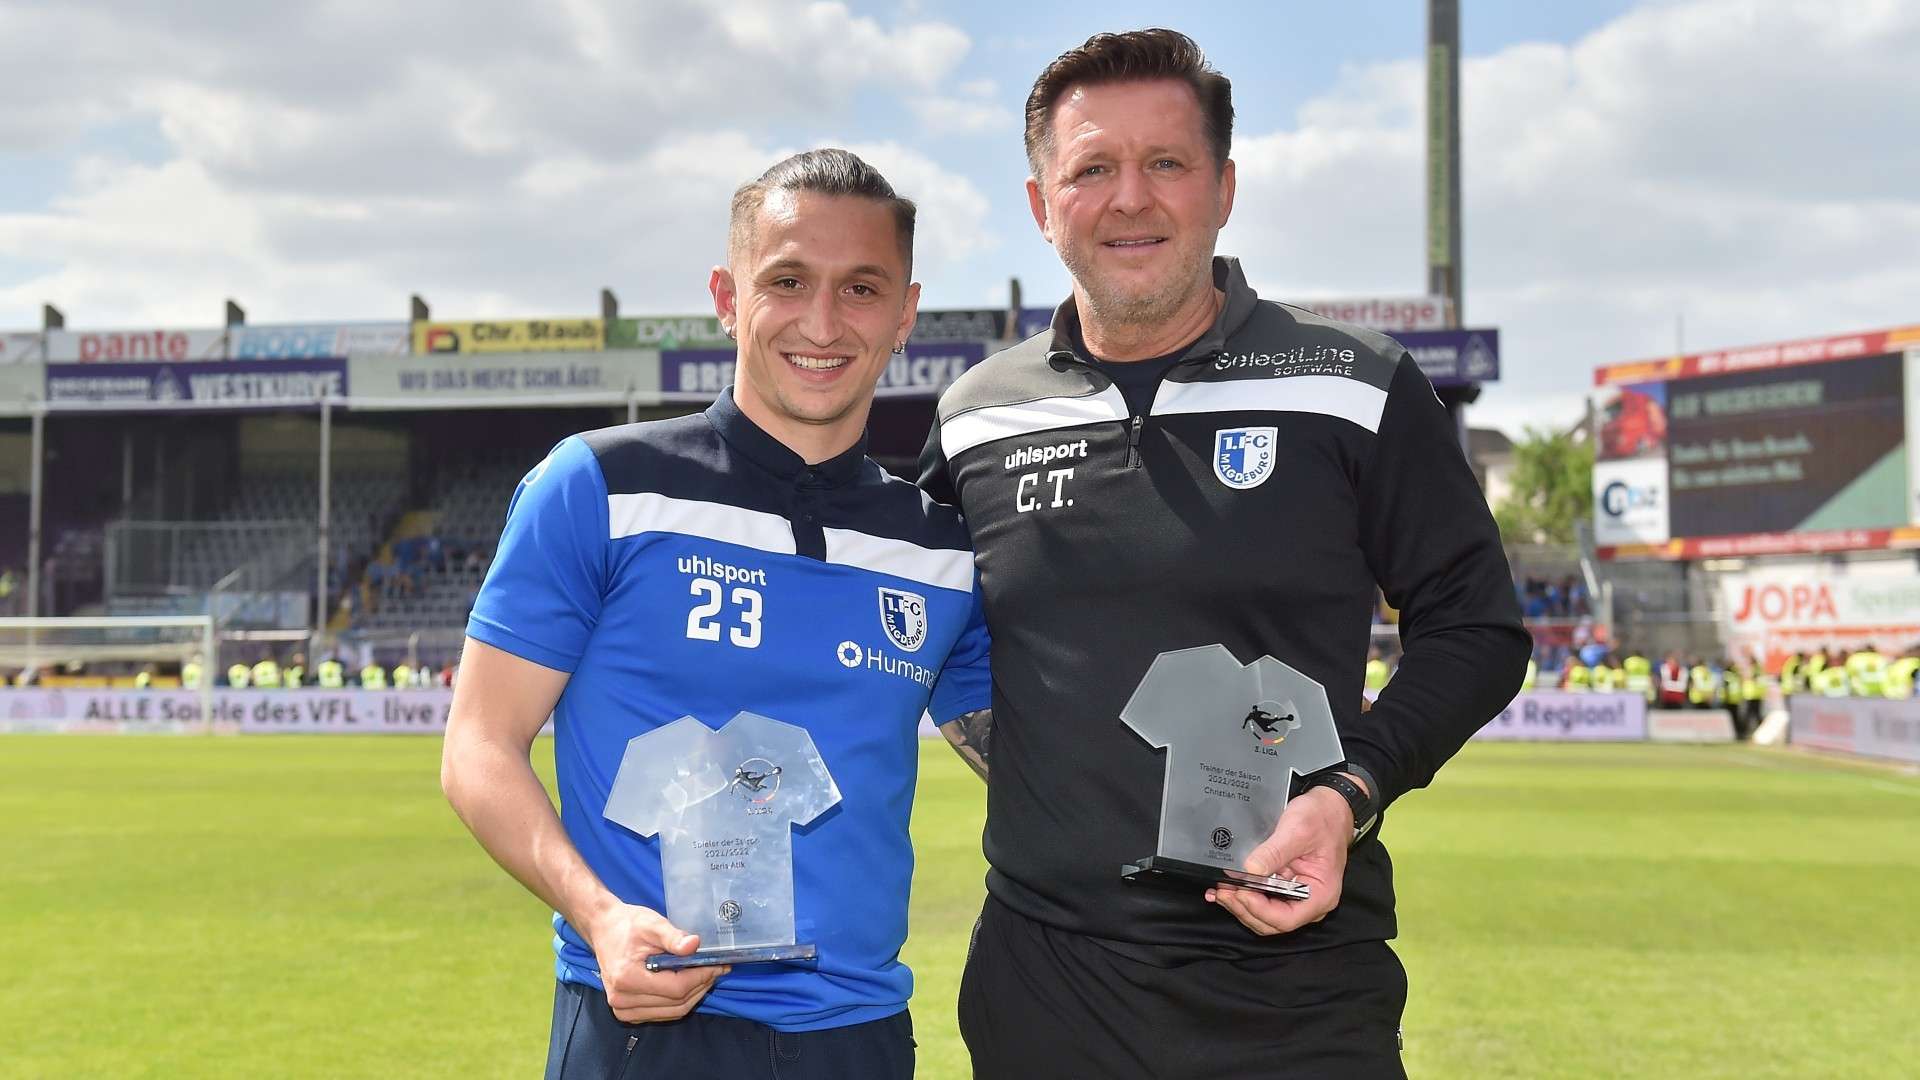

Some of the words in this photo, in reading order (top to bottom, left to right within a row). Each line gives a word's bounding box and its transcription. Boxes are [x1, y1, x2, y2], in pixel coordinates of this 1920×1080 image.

[79, 328, 189, 362] pante
[471, 321, 522, 343] Chr.
[528, 319, 596, 342] Staub
[1273, 364, 1353, 377] SOFTWARE
[1005, 439, 1088, 470] uhlsport
[1219, 451, 1269, 482] MAGDEBURG
[678, 555, 766, 586] uhlsport
[686, 578, 763, 649] 23
[1734, 583, 1839, 622] JOPA
[886, 613, 923, 646] MAGDEBURG
[85, 698, 150, 721] ALLE
[253, 697, 302, 724] des
[307, 698, 358, 723] VFL
[383, 697, 434, 723] live
[1524, 700, 1626, 732] Region!
[1262, 746, 1278, 757] LIGA
[1200, 762, 1224, 774] Trainer
[1225, 767, 1237, 777] der
[1238, 770, 1262, 782] Saison
[1204, 786, 1236, 799] Christian
[1237, 792, 1251, 802] Titz
